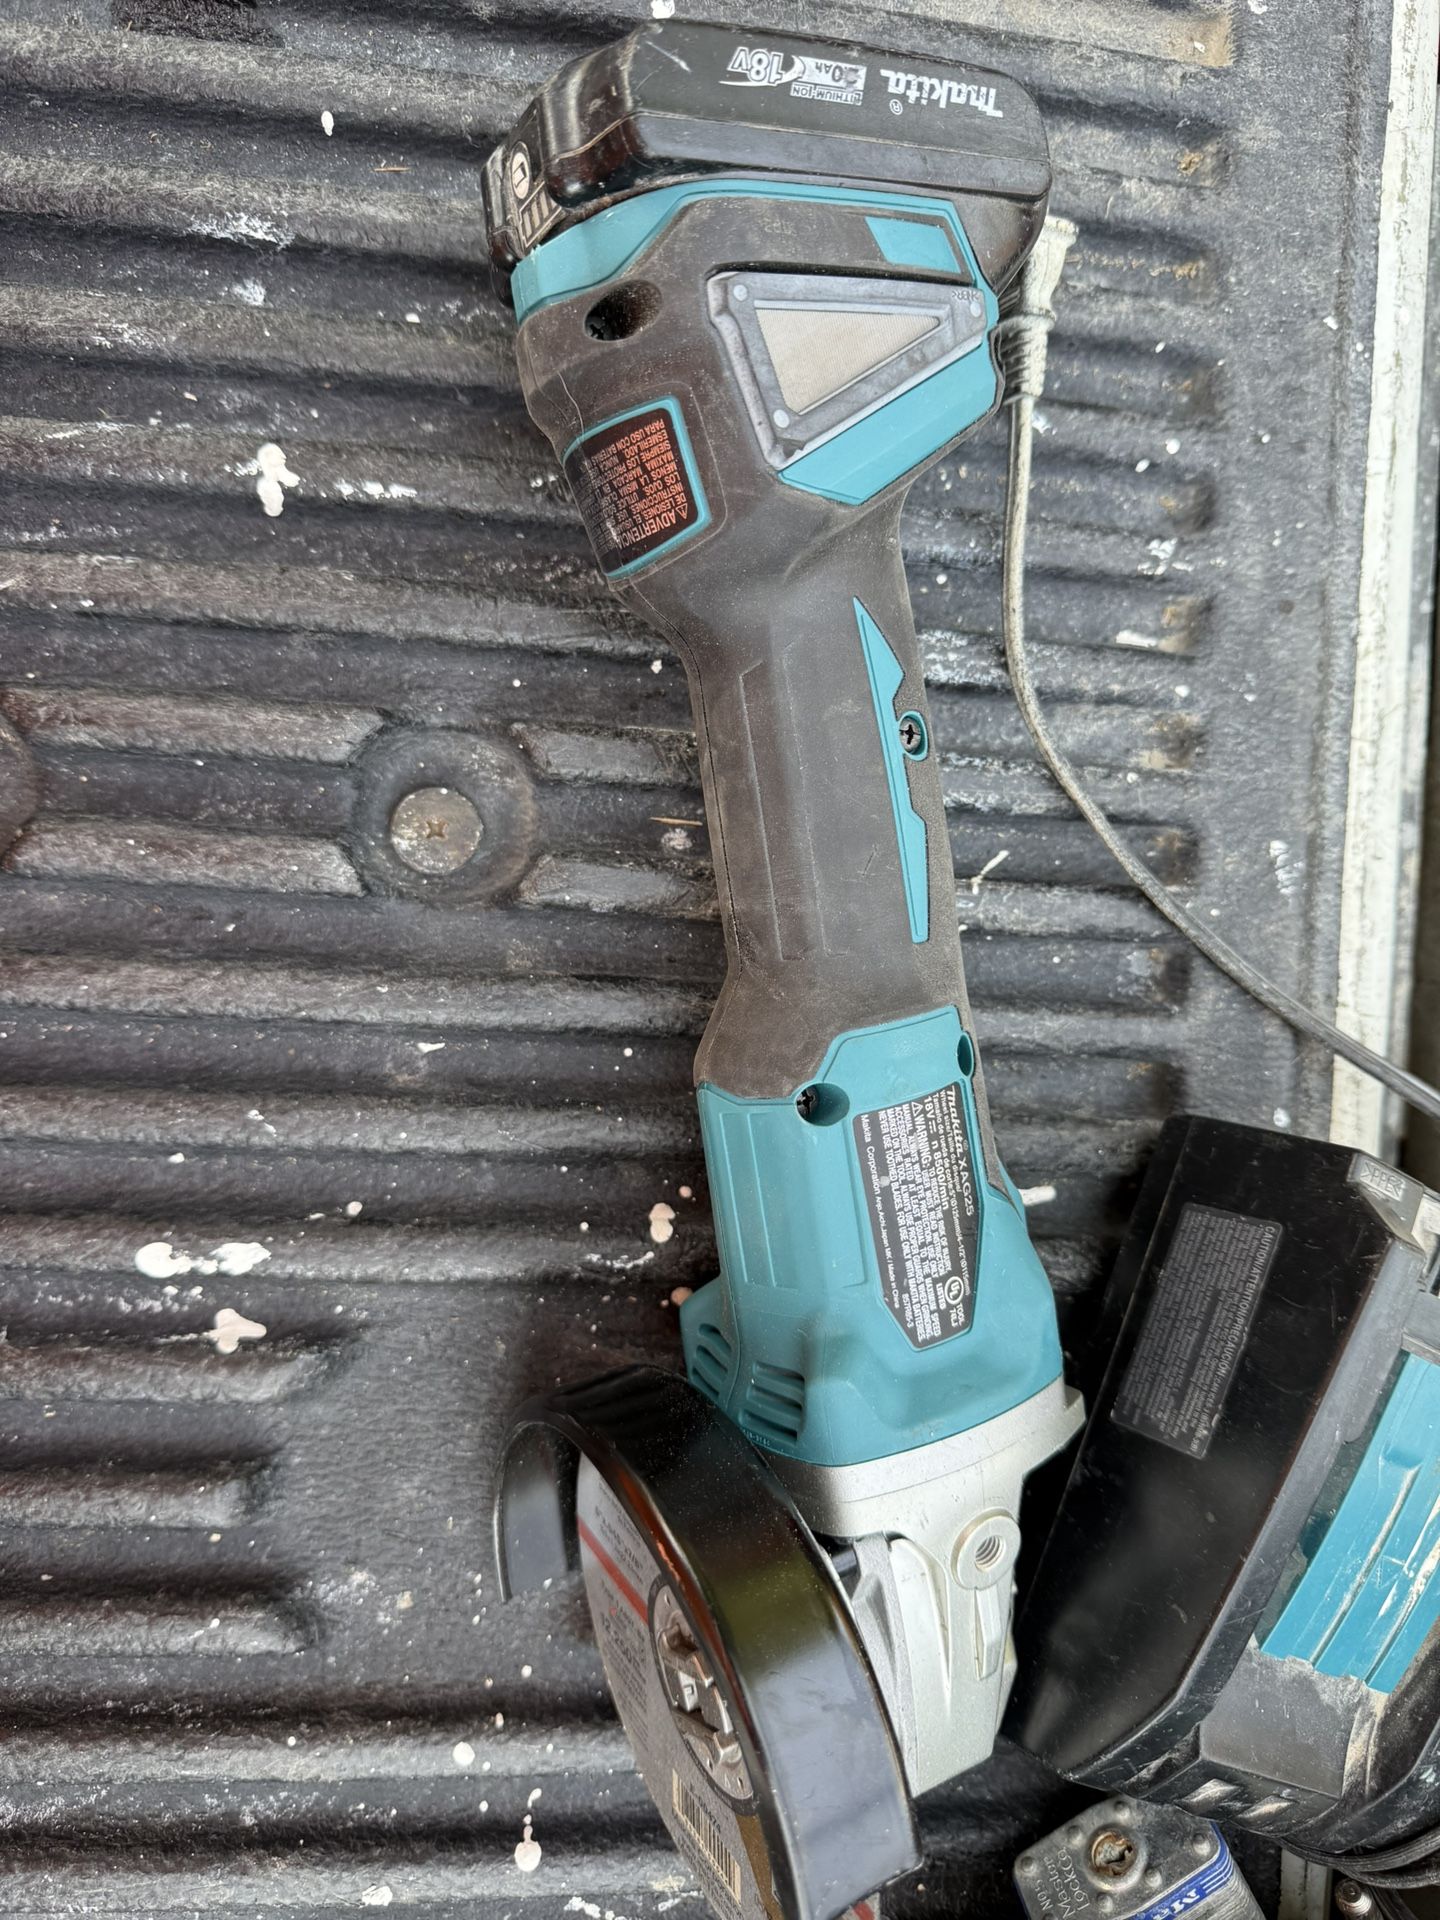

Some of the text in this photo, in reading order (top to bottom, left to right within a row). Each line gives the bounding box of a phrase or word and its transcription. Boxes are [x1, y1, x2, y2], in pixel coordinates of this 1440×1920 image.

[628, 428, 645, 442] USO
[643, 418, 665, 435] PARA
[614, 436, 631, 450] CON
[638, 439, 671, 462] SIEMPRE
[625, 454, 641, 468] LOS
[649, 460, 677, 480] MENOS
[638, 474, 650, 486] LA
[663, 470, 680, 485] LOS
[673, 491, 687, 504] DE
[939, 1089, 948, 1114] Wheel
[860, 1114, 872, 1142] Makita
[878, 1110, 889, 1133] NEVER
[886, 1108, 898, 1137] MARKED
[894, 1106, 909, 1155] ACCESSORIES
[883, 1134, 891, 1148] USE
[891, 1137, 900, 1148] ON
[913, 1113, 932, 1168] WARNING:
[893, 1148, 902, 1163] THE
[923, 1095, 935, 1118] 18V
[933, 1151, 950, 1210] 8500/min
[865, 1145, 881, 1194] Corporation
[885, 1149, 897, 1180] TOOTHED
[903, 1157, 913, 1180] RATED
[912, 1162, 922, 1183] WEAR
[928, 1166, 935, 1176] TO
[908, 1183, 916, 1192] AT
[921, 1169, 930, 1188] USER
[957, 1157, 974, 1217] XAG25
[900, 1184, 911, 1212] ALWAYS
[916, 1185, 925, 1199] EYE
[925, 1190, 933, 1209] MUST
[930, 1177, 940, 1205] REDUCE
[910, 1195, 920, 1217] LEAST
[935, 1205, 943, 1219] THE
[896, 1211, 904, 1226] FOR
[905, 1212, 913, 1226] USE
[928, 1210, 937, 1229] READ
[937, 1219, 945, 1236] RISK
[898, 1226, 907, 1241] USE
[907, 1226, 918, 1254] PROPER
[914, 1220, 924, 1245] EQUAL
[940, 1236, 947, 1246] OF
[901, 1241, 910, 1259] ONLY
[919, 1246, 927, 1257] TO
[887, 1263, 895, 1281] Made
[904, 1259, 914, 1278] WITH
[912, 1254, 923, 1284] GUARDS
[921, 1259, 930, 1275] THE
[891, 1289, 900, 1309] China
[908, 1277, 919, 1303] MAKITA
[917, 1283, 927, 1304] WHEN
[934, 1282, 947, 1310] LISTED
[930, 1312, 941, 1336] SPEED
